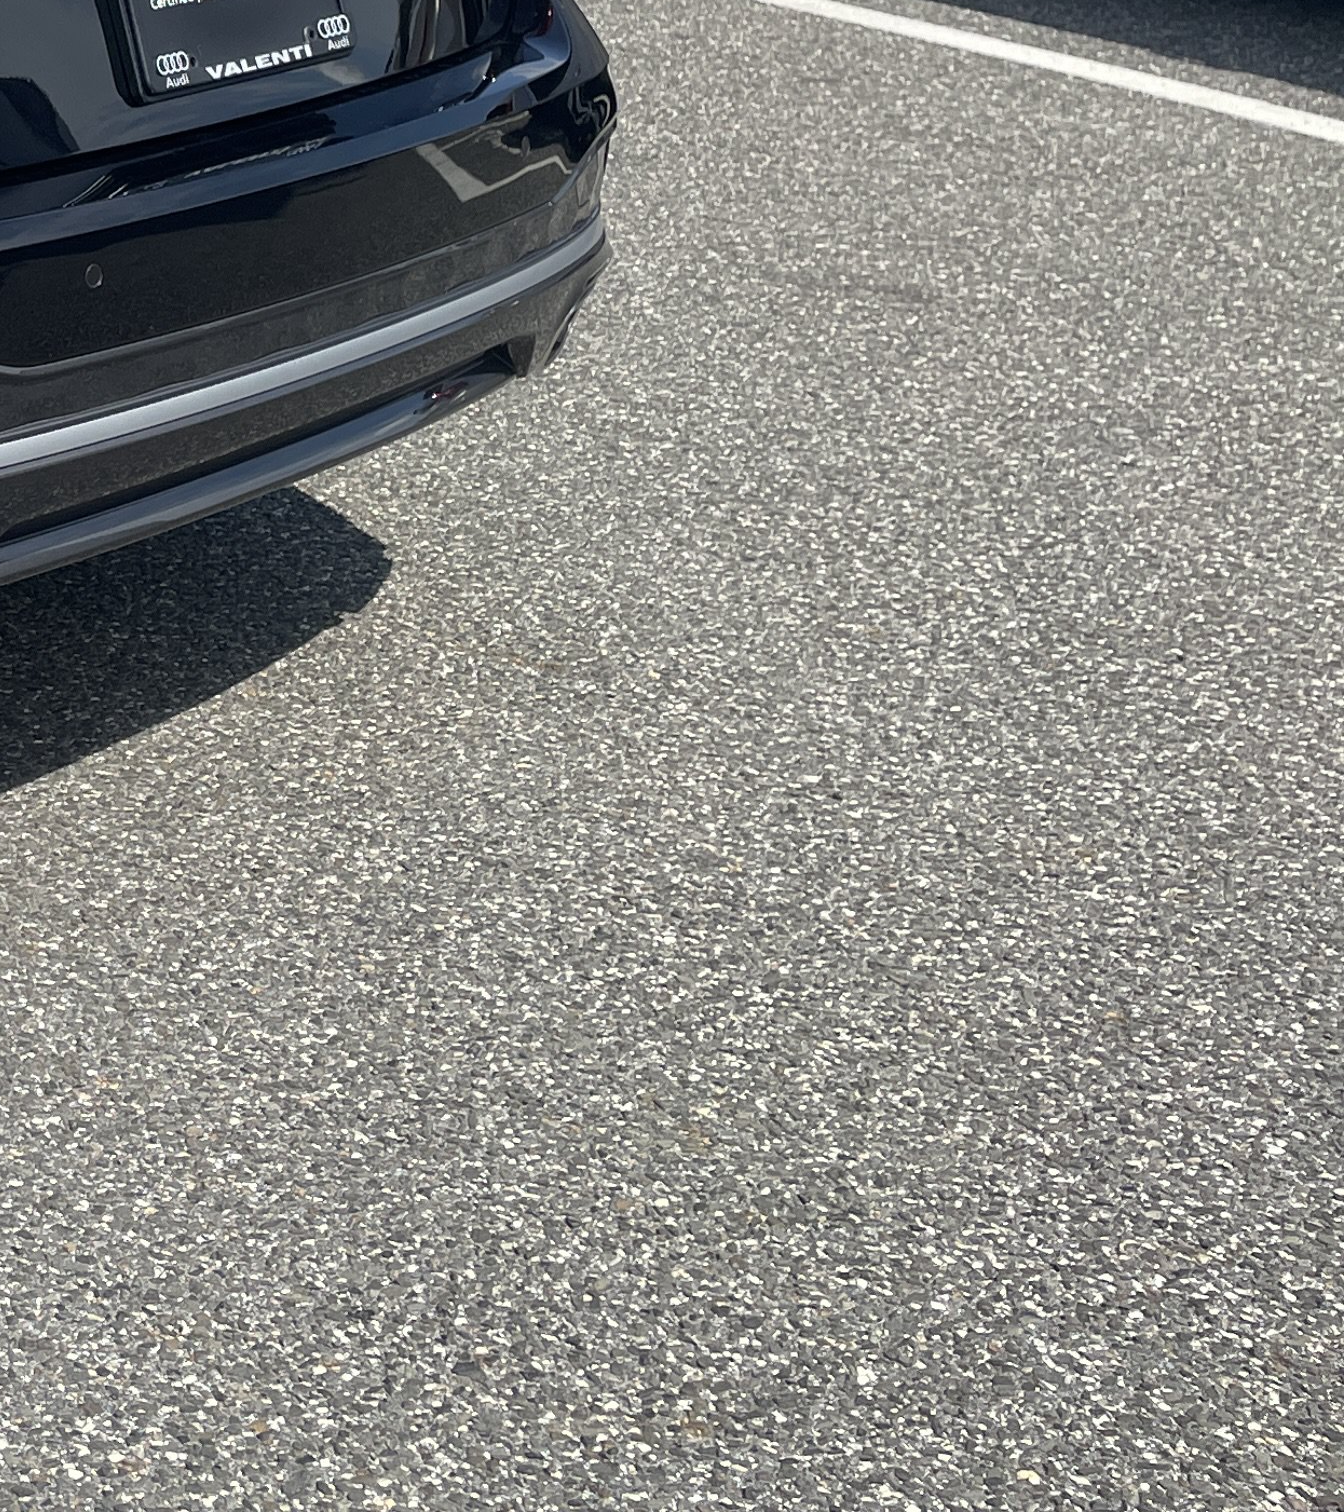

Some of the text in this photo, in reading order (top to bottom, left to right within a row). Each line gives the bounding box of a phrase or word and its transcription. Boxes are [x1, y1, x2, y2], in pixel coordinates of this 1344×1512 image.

[328, 38, 350, 50] Audi
[205, 43, 313, 80] VALENTI
[166, 75, 190, 89] Audi
